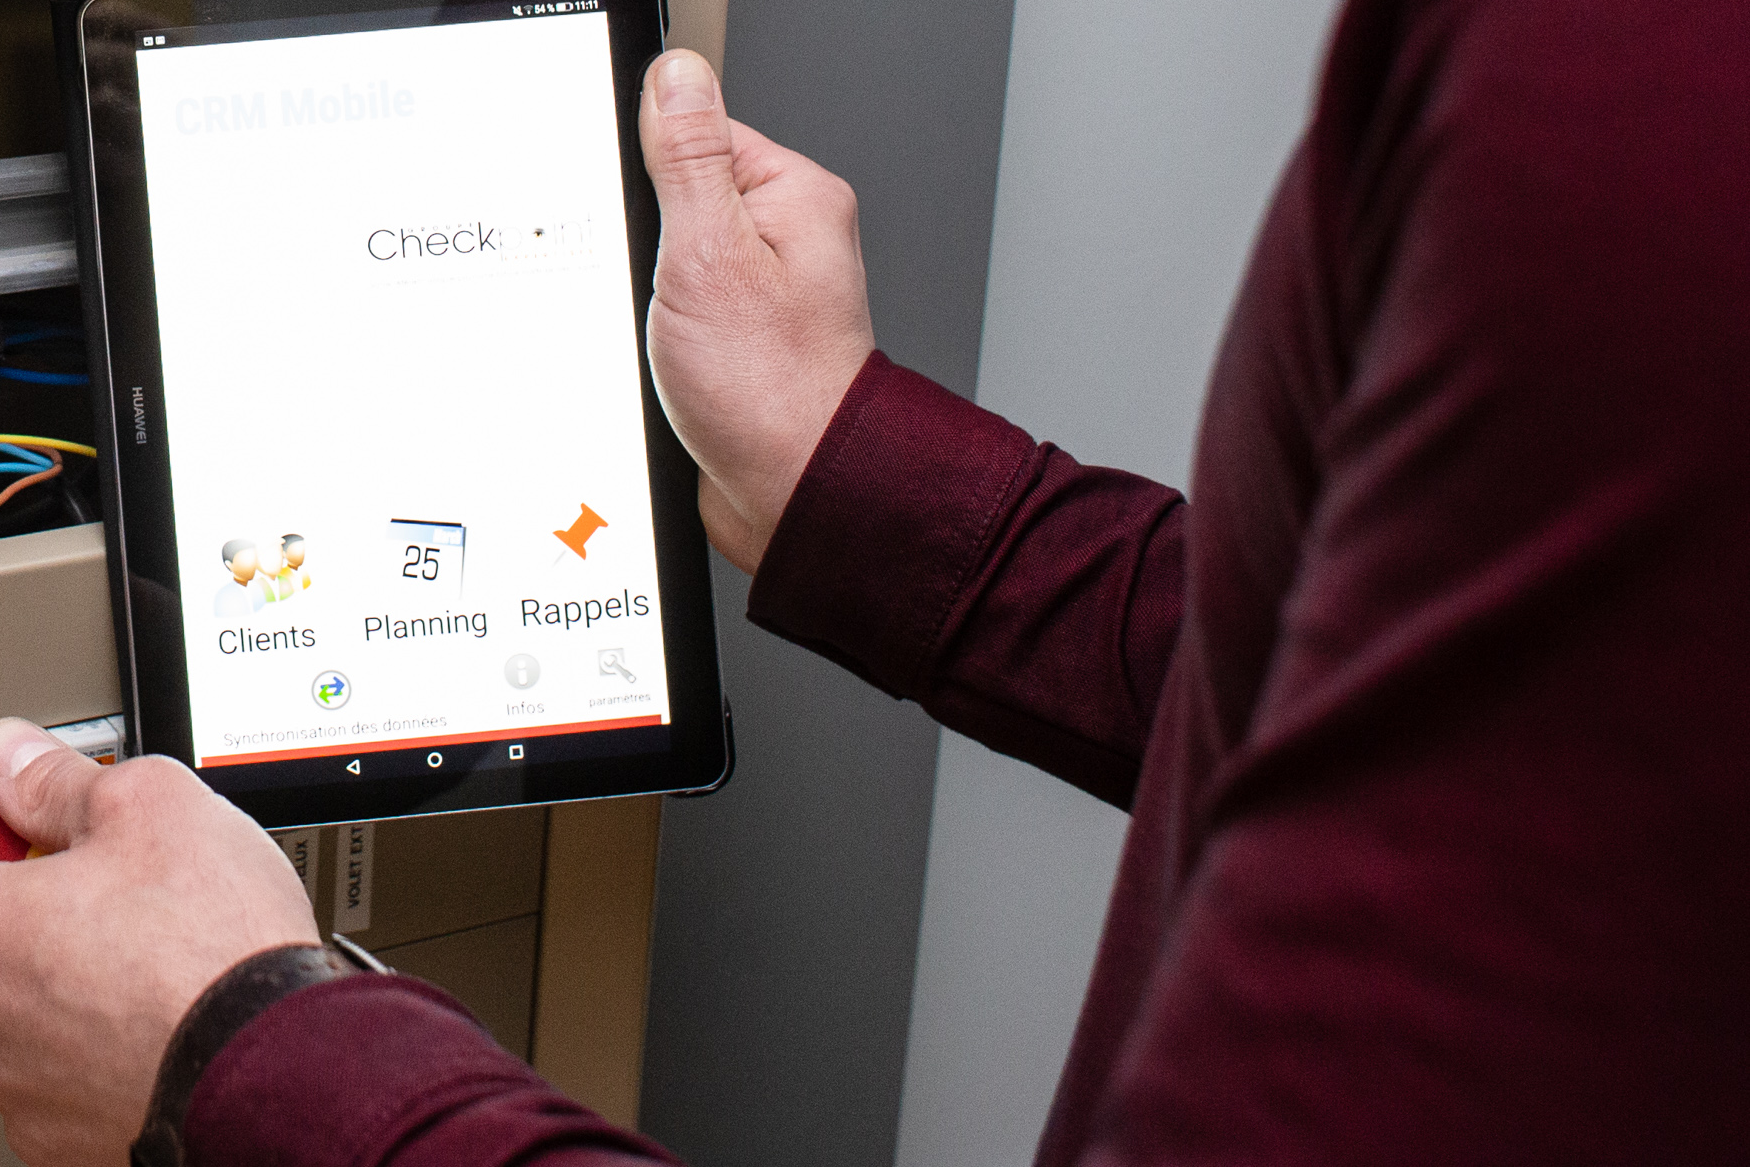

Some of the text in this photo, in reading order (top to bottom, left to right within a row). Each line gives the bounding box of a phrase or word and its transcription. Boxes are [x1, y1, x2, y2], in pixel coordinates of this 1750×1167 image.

[534, 4, 546, 14] 54
[574, 0, 598, 11] 11:11
[175, 79, 416, 136] CRM Mobile
[132, 386, 147, 445] HUAWEI
[402, 545, 440, 581] 25
[364, 609, 488, 641] Planning
[521, 588, 649, 630] Rappels
[218, 626, 316, 654] Clients
[506, 701, 545, 716] Infos
[223, 715, 447, 748] Synchronisation des données
[348, 861, 363, 909] VOLET
